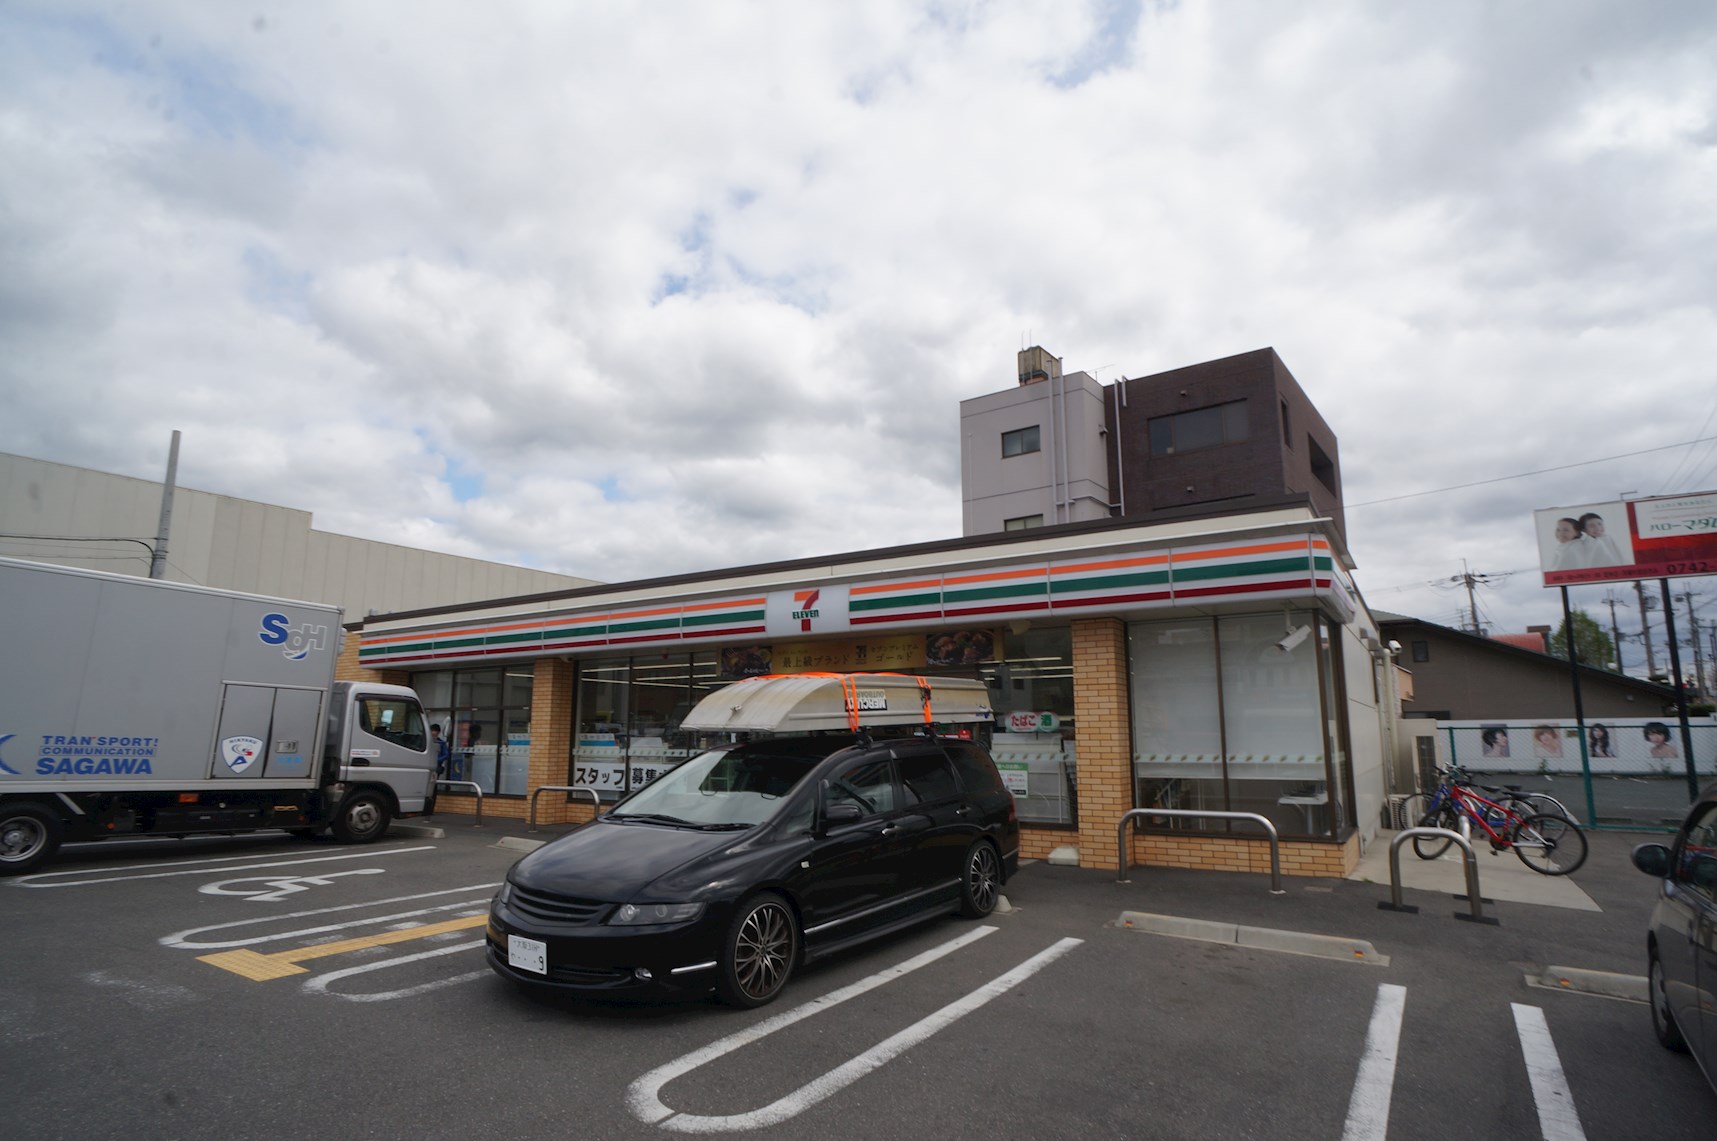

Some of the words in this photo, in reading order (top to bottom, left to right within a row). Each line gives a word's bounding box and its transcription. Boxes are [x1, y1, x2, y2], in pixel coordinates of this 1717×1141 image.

[793, 589, 819, 632] 7
[783, 654, 849, 668] 最上級ブランド
[875, 652, 912, 663] ゴールド
[1011, 714, 1037, 727] たばこ
[42, 747, 154, 756] COMMUNICATION
[35, 757, 153, 775] SAGAWA
[575, 767, 625, 786] スタッフ
